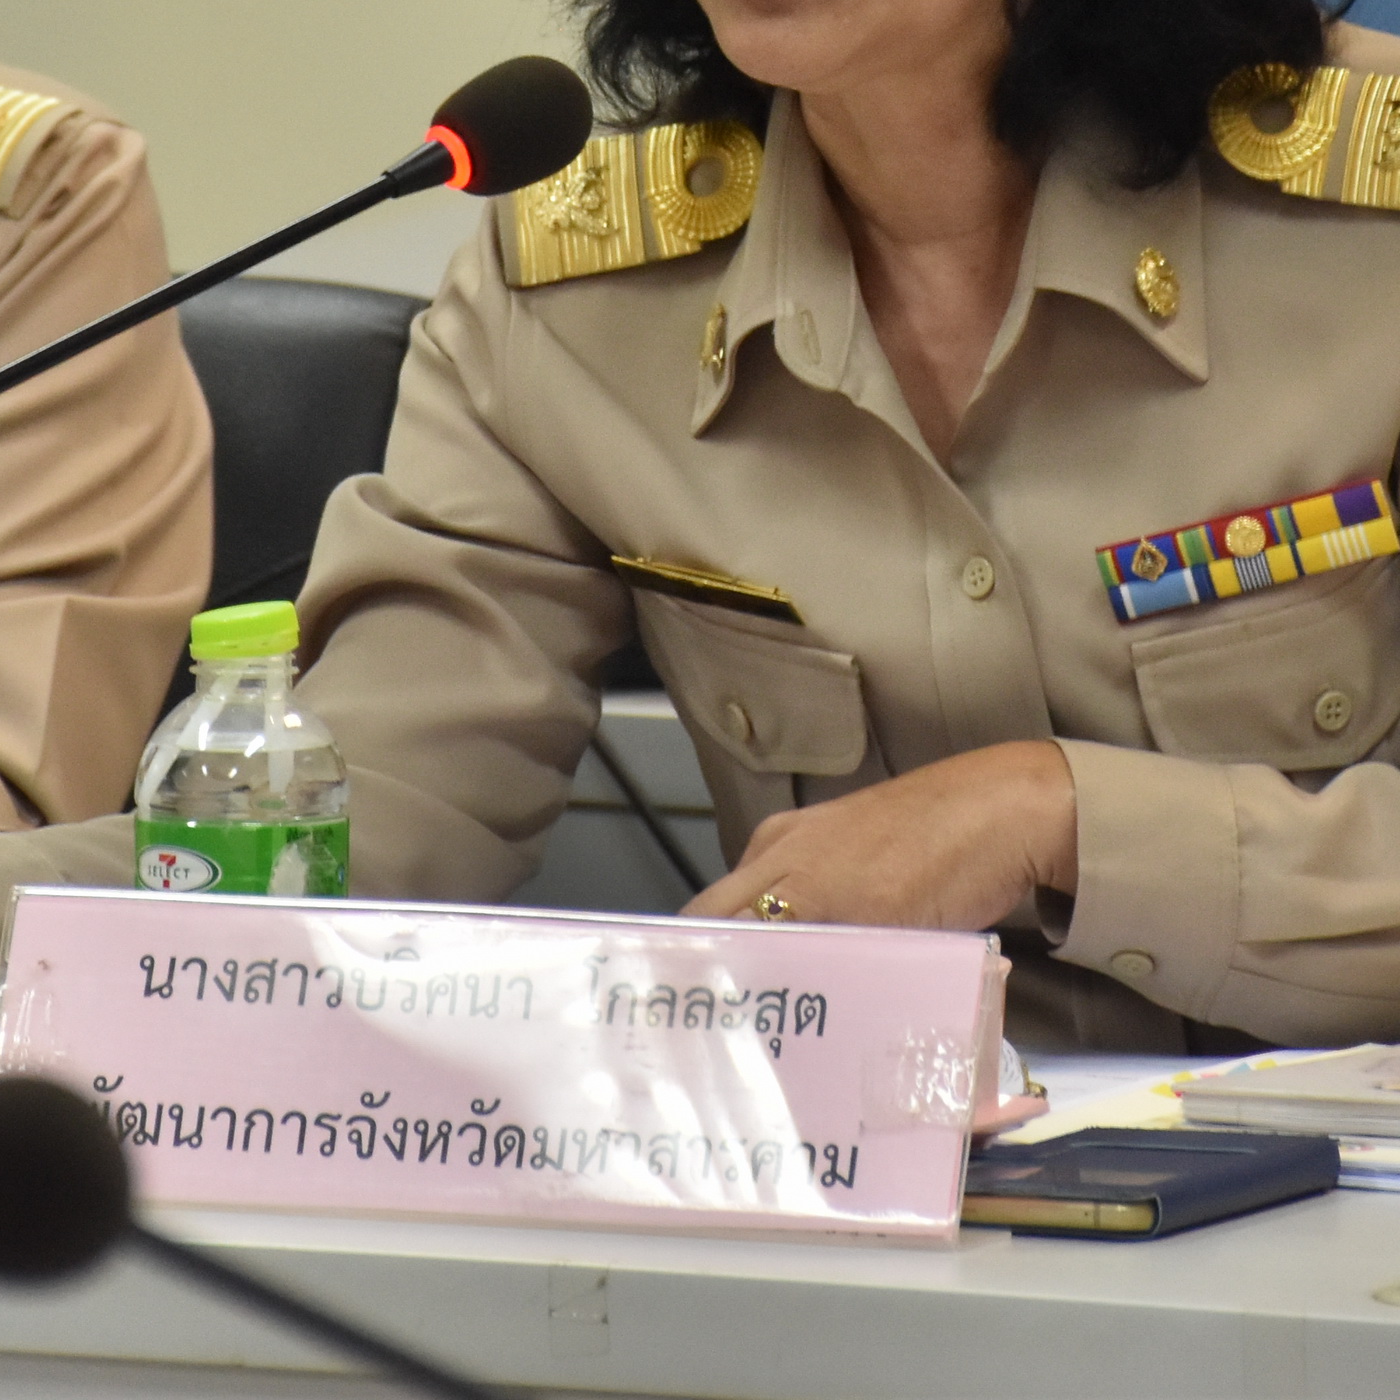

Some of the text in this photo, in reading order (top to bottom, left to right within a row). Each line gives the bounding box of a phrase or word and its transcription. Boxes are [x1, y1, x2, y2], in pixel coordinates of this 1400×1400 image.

[147, 864, 191, 880] SELECT
[90, 1074, 861, 1190] ัฒนาการจังหวัดมหาสารคาม
